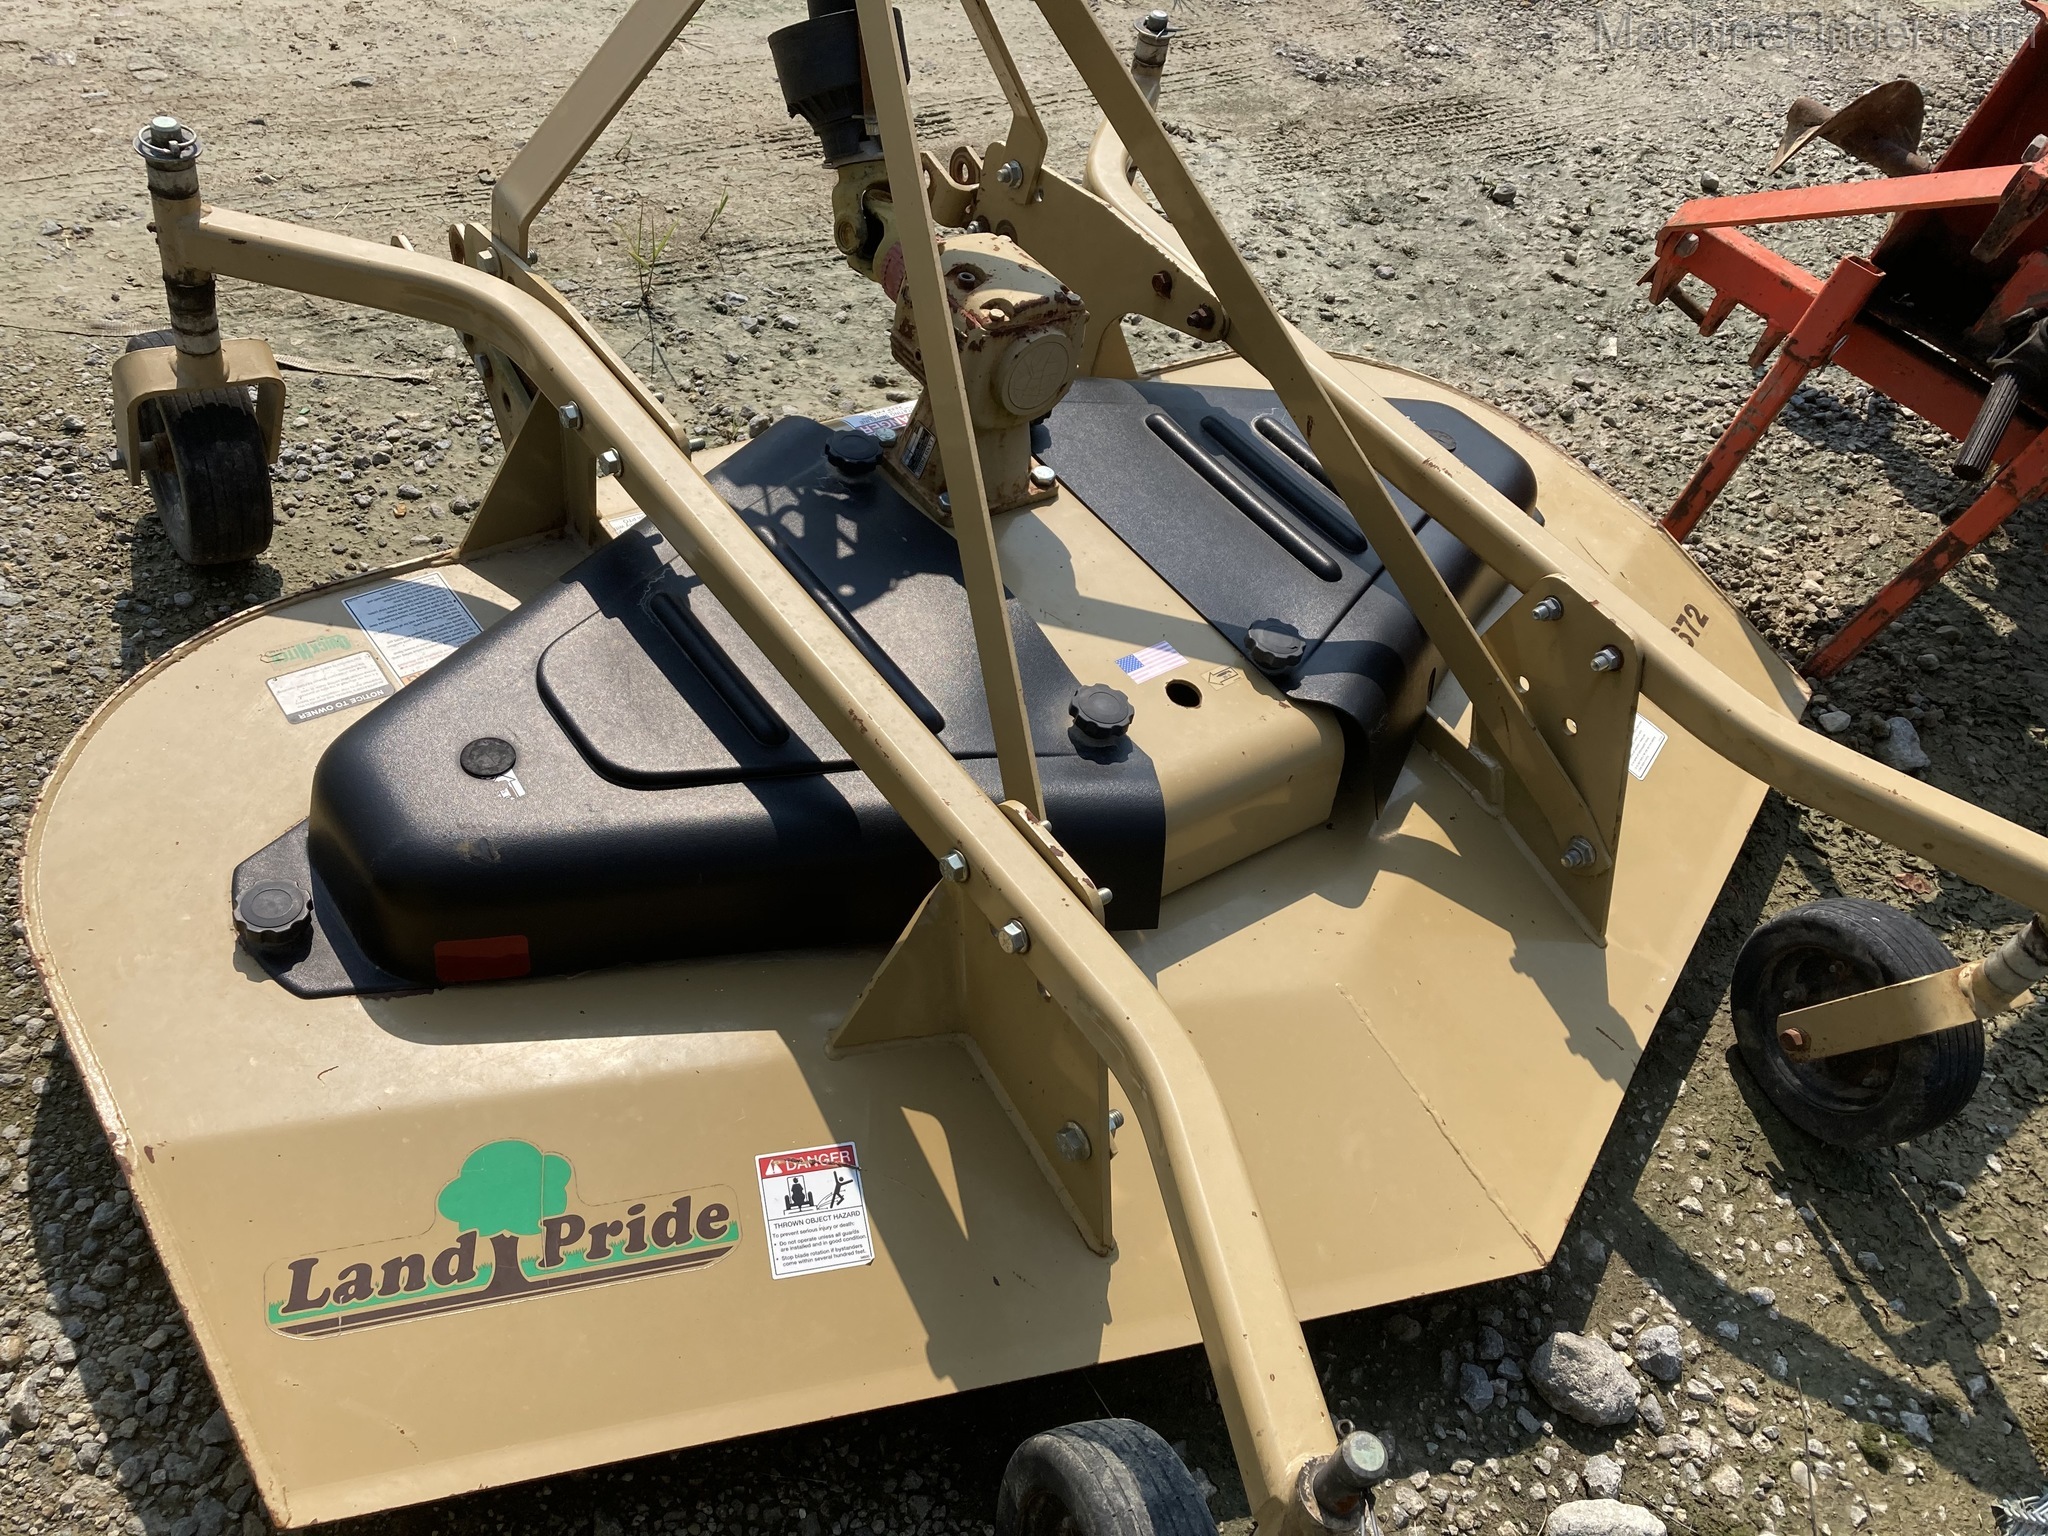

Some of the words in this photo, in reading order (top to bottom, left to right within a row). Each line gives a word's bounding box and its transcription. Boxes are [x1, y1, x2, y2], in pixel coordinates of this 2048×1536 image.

[860, 413, 911, 435] ANGER
[351, 689, 385, 704] NOTICE
[298, 704, 334, 719] OWNER
[335, 700, 350, 709] TO
[785, 1150, 851, 1172] DANGER
[805, 1215, 832, 1224] OBJECT
[833, 1210, 860, 1219] HAZARD
[281, 1229, 478, 1314] Land
[540, 1195, 730, 1269] Pride
